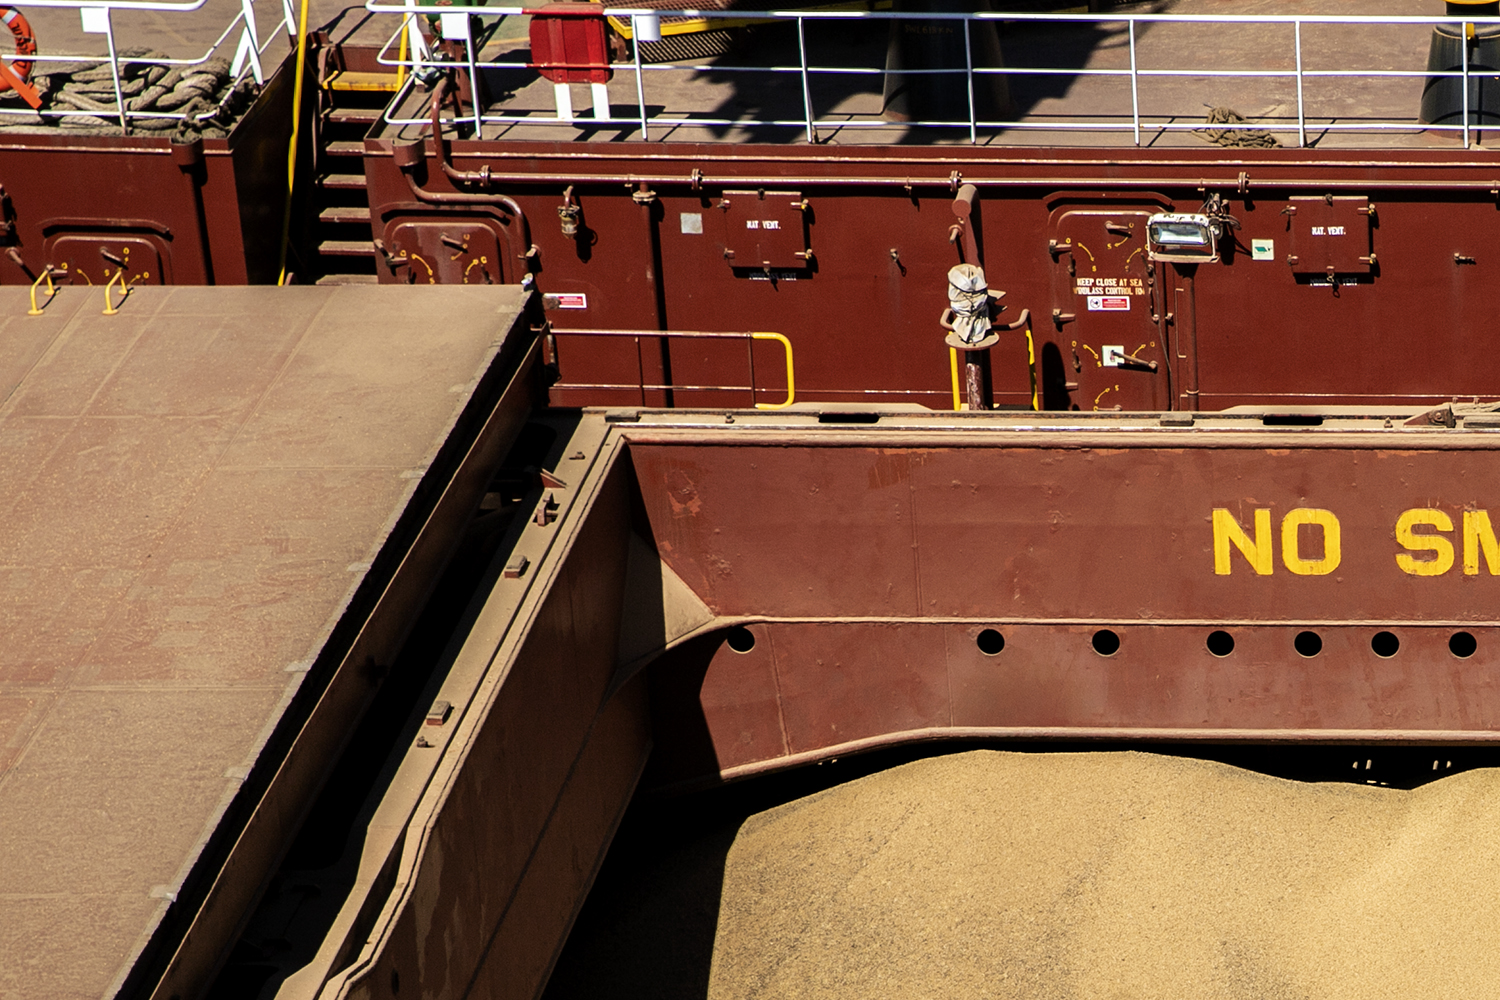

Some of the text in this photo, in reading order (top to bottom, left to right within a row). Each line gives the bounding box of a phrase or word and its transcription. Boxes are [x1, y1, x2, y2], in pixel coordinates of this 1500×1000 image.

[1096, 278, 1117, 286] CLOSE
[1120, 278, 1127, 286] AT
[1130, 278, 1142, 286] SEA
[1212, 508, 1341, 576] NO
